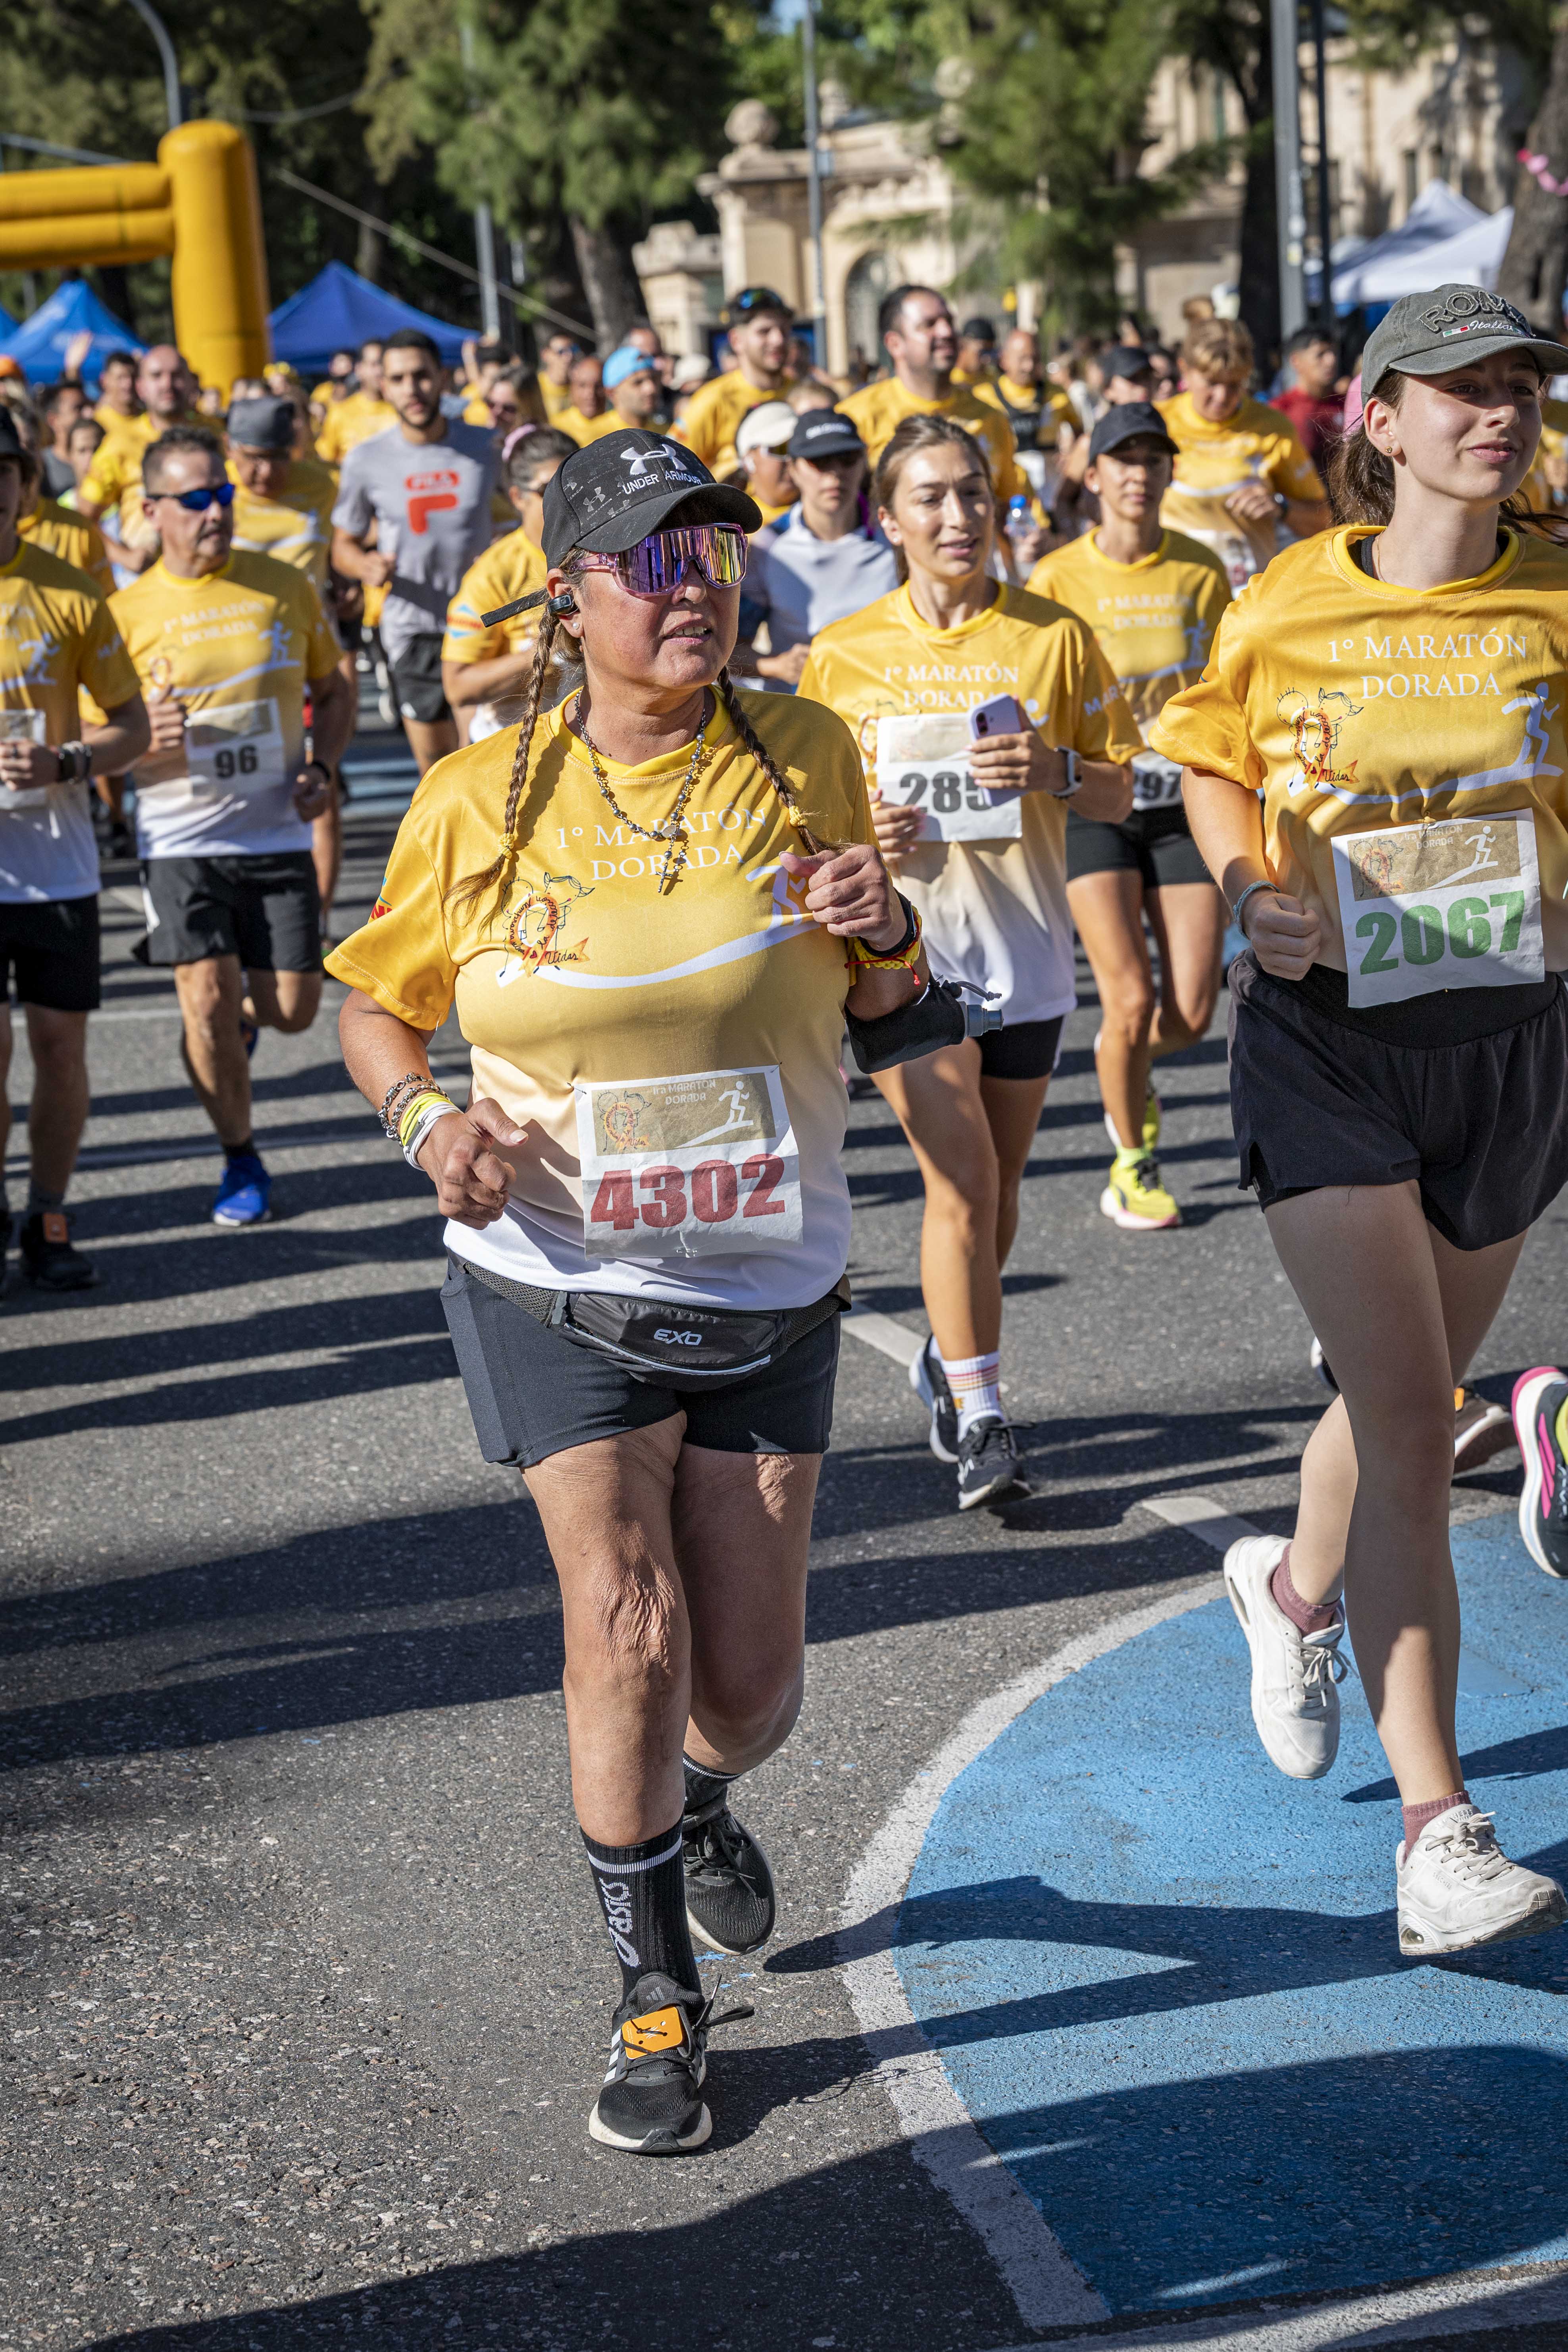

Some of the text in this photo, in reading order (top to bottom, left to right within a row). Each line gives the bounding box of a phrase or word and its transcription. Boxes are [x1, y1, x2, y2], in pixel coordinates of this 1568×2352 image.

[622, 473, 660, 495] UNDER
[665, 470, 703, 485] ARMOUR
[1328, 627, 1528, 663] 1° MARATÓN
[906, 660, 1019, 683] MARATÓN
[903, 689, 997, 708] DORAD
[1360, 672, 1503, 699] DORADA
[215, 745, 258, 779] 96
[557, 802, 766, 849] 1° MARATÓN
[1416, 836, 1454, 850] DORADA
[591, 844, 744, 880] DORADA
[1355, 890, 1525, 975] 2067
[665, 1091, 706, 1105] DORADA
[668, 1079, 717, 1092] MARATON
[591, 1153, 785, 1230] 4302
[654, 1329, 702, 1345] EXO
